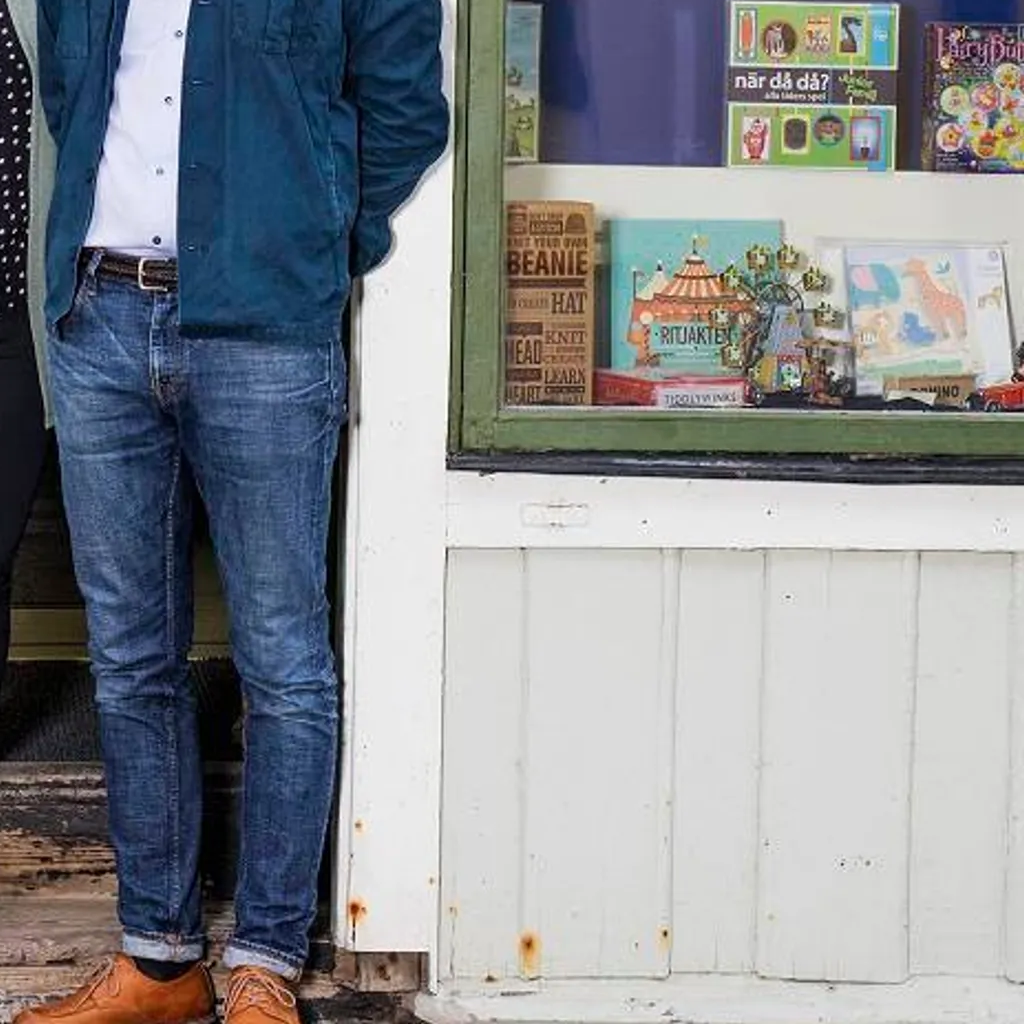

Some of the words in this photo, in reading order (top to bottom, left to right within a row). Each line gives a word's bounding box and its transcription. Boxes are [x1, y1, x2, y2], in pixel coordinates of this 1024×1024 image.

[734, 72, 766, 89] när
[770, 71, 793, 90] då
[796, 72, 830, 91] då?
[507, 250, 588, 276] BEANIE
[551, 291, 587, 314] HAT
[544, 330, 587, 345] KNIT
